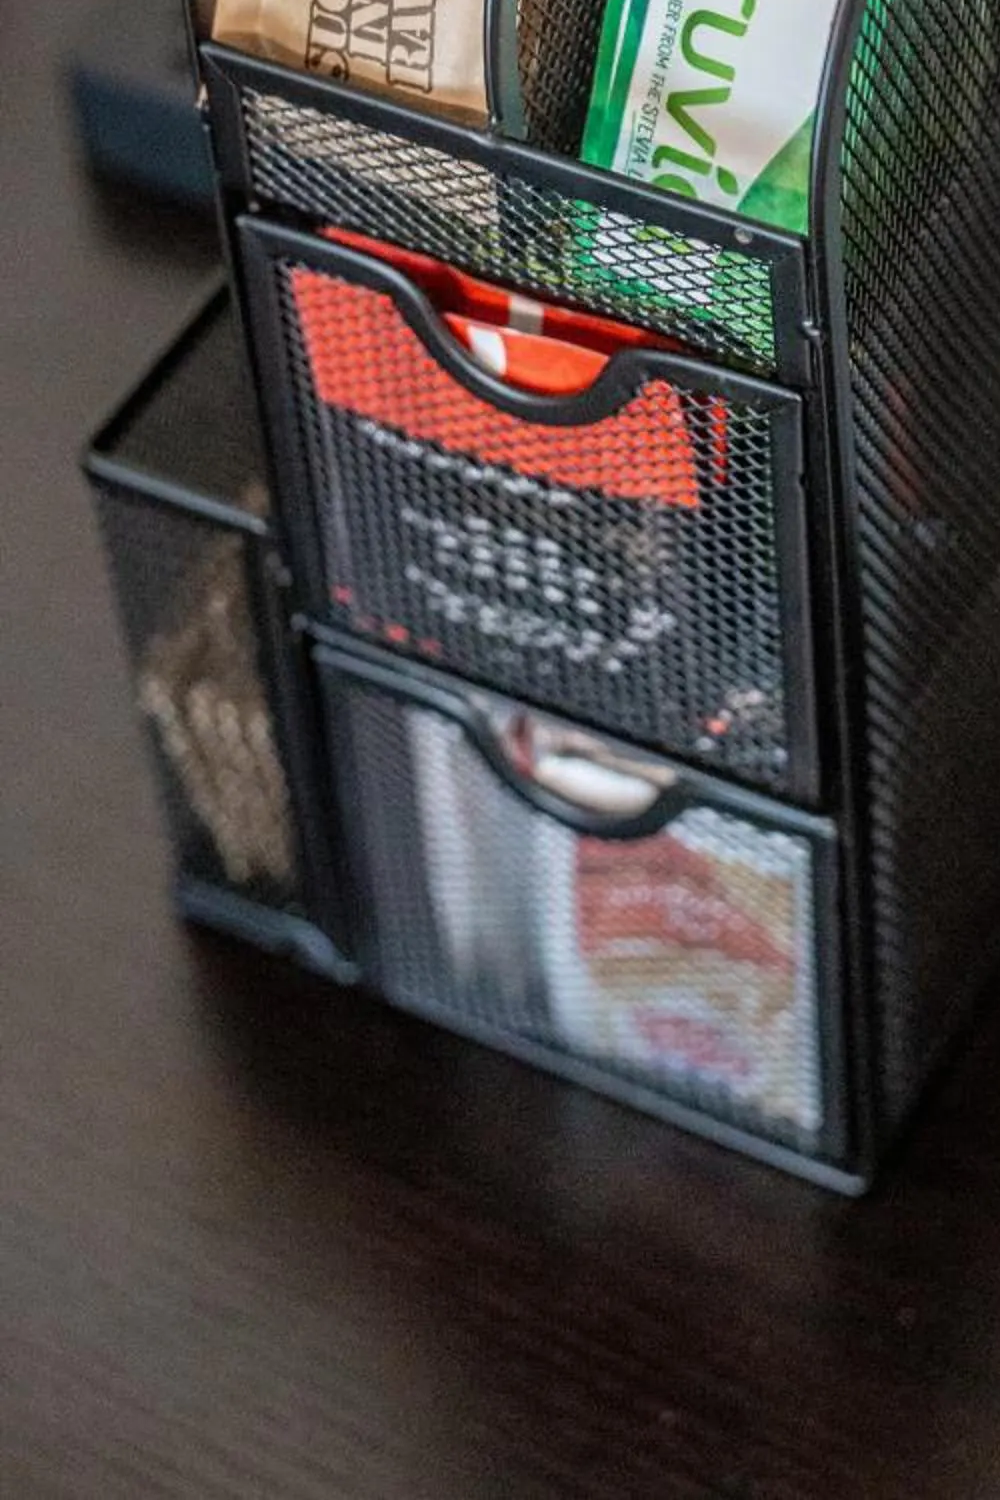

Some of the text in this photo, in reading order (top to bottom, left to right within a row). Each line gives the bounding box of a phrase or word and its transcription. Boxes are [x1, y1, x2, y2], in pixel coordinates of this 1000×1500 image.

[655, 23, 677, 70] FROM
[646, 75, 667, 107] THE
[632, 102, 661, 166] STEVIA
